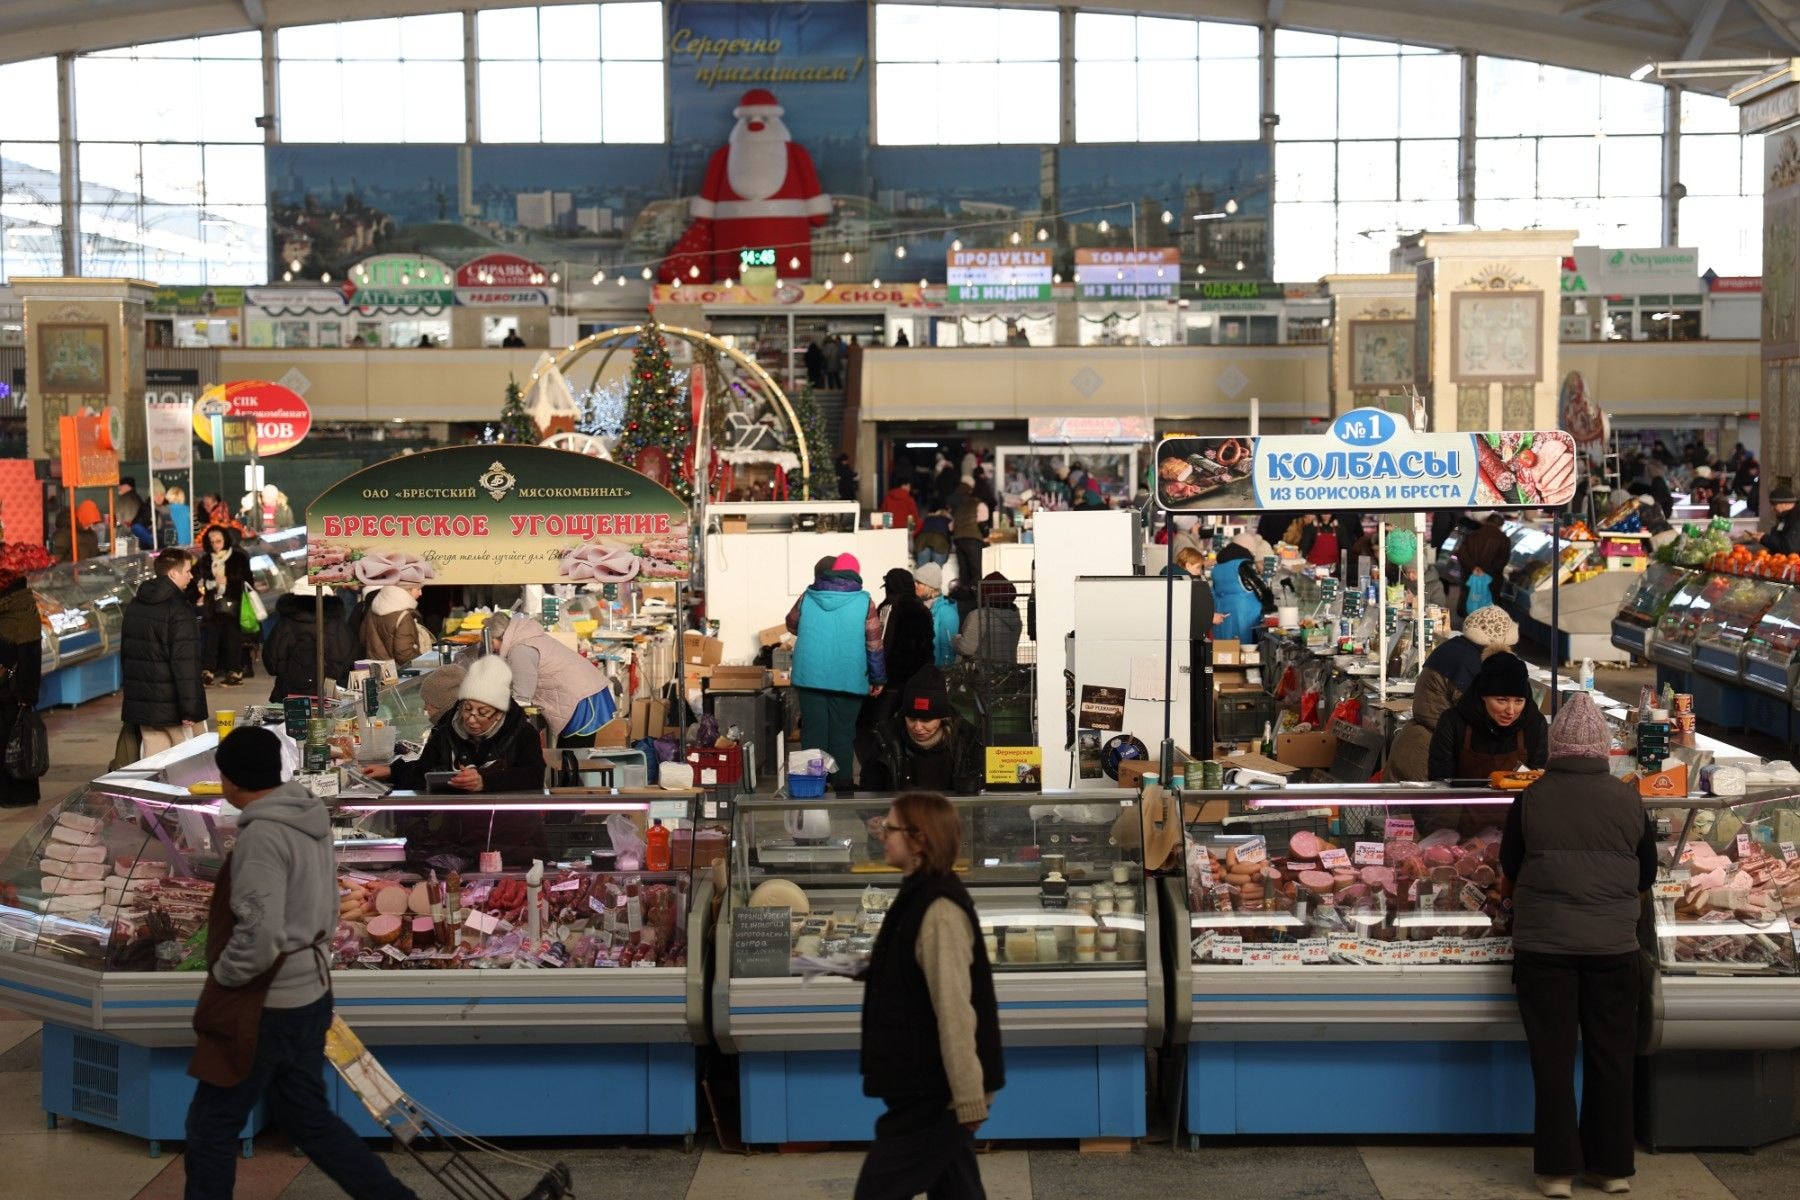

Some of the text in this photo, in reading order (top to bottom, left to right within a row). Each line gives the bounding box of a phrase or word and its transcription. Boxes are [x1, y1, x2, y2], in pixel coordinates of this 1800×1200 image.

[672, 28, 782, 60] Сердечно
[695, 56, 865, 90] приглашаем!
[740, 249, 775, 265] 14:45
[954, 251, 1046, 266] ПРОДУКТЫ
[1091, 252, 1164, 263] ТОВАРЫ
[361, 290, 443, 305] АПТЕКА
[840, 290, 903, 302] СНОВ
[960, 286, 1039, 300] ИЗ ИНДИИ
[1083, 284, 1172, 300] ИЗ ИНДИИ
[1204, 282, 1260, 298] ОДЕЖДА
[470, 293, 538, 303] РАДИОУЗЕЛ
[233, 396, 258, 406] СПК
[1267, 450, 1462, 480] КОЛБАСЫ
[363, 486, 632, 499] ОАО «БРЕСТСКИЙ МЯСОКОМБИНАТ»
[1270, 484, 1461, 501] ИЗ БОРИСОВА И БРЕСТА
[322, 513, 672, 541] БРЕСТСКОЕ УГОЩЕНИЕ
